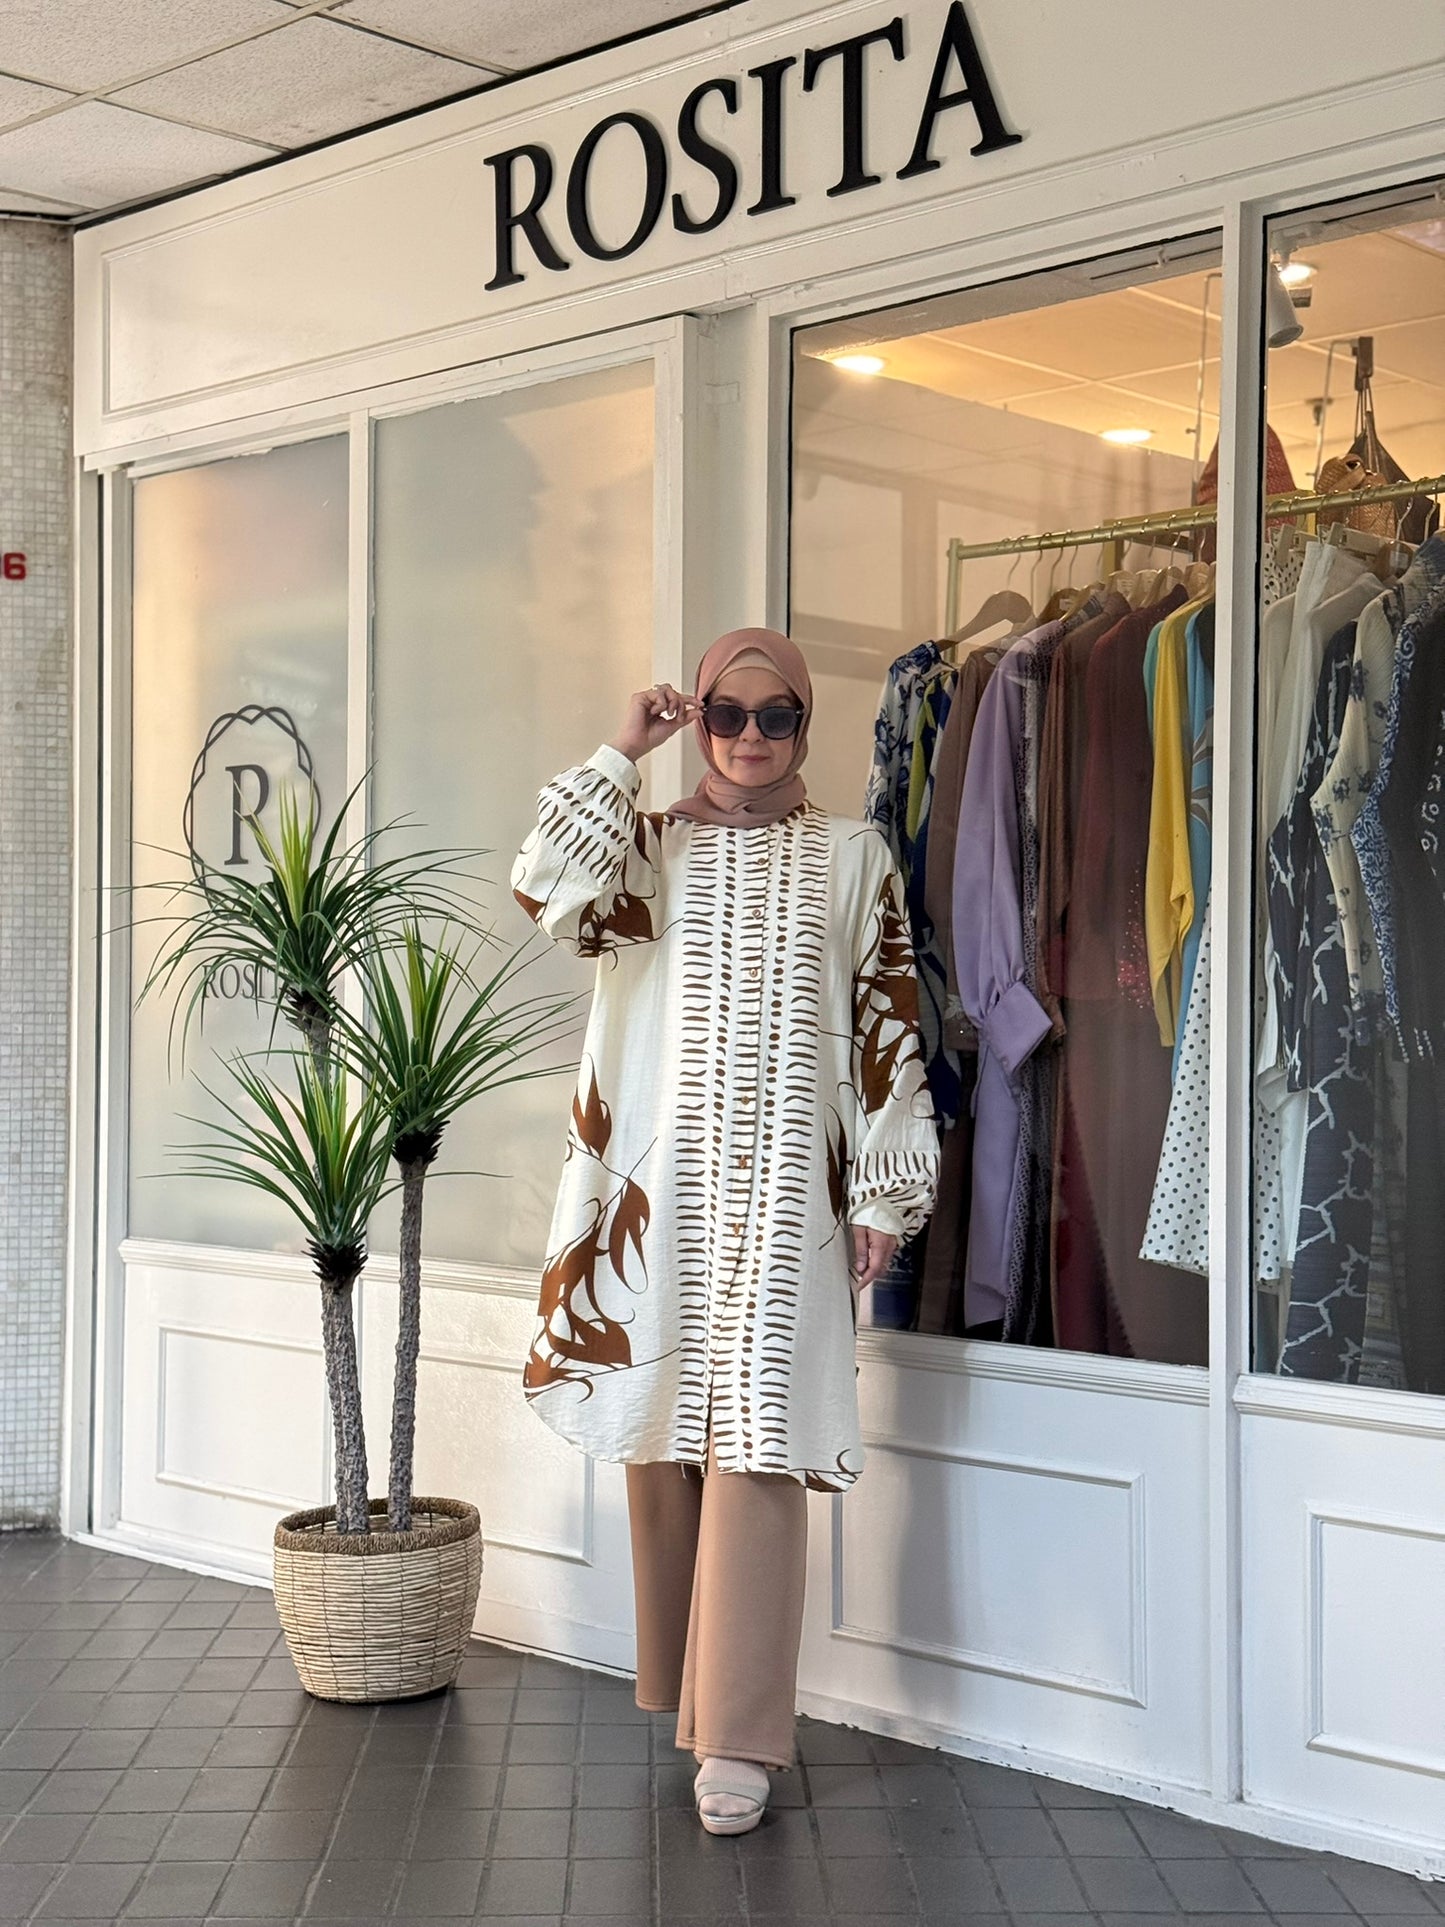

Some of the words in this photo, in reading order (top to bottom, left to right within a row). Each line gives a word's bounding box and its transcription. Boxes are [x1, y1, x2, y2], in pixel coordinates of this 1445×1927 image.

[484, 1, 1023, 290] ROSITA
[0, 552, 27, 581] 6
[224, 764, 272, 866] R
